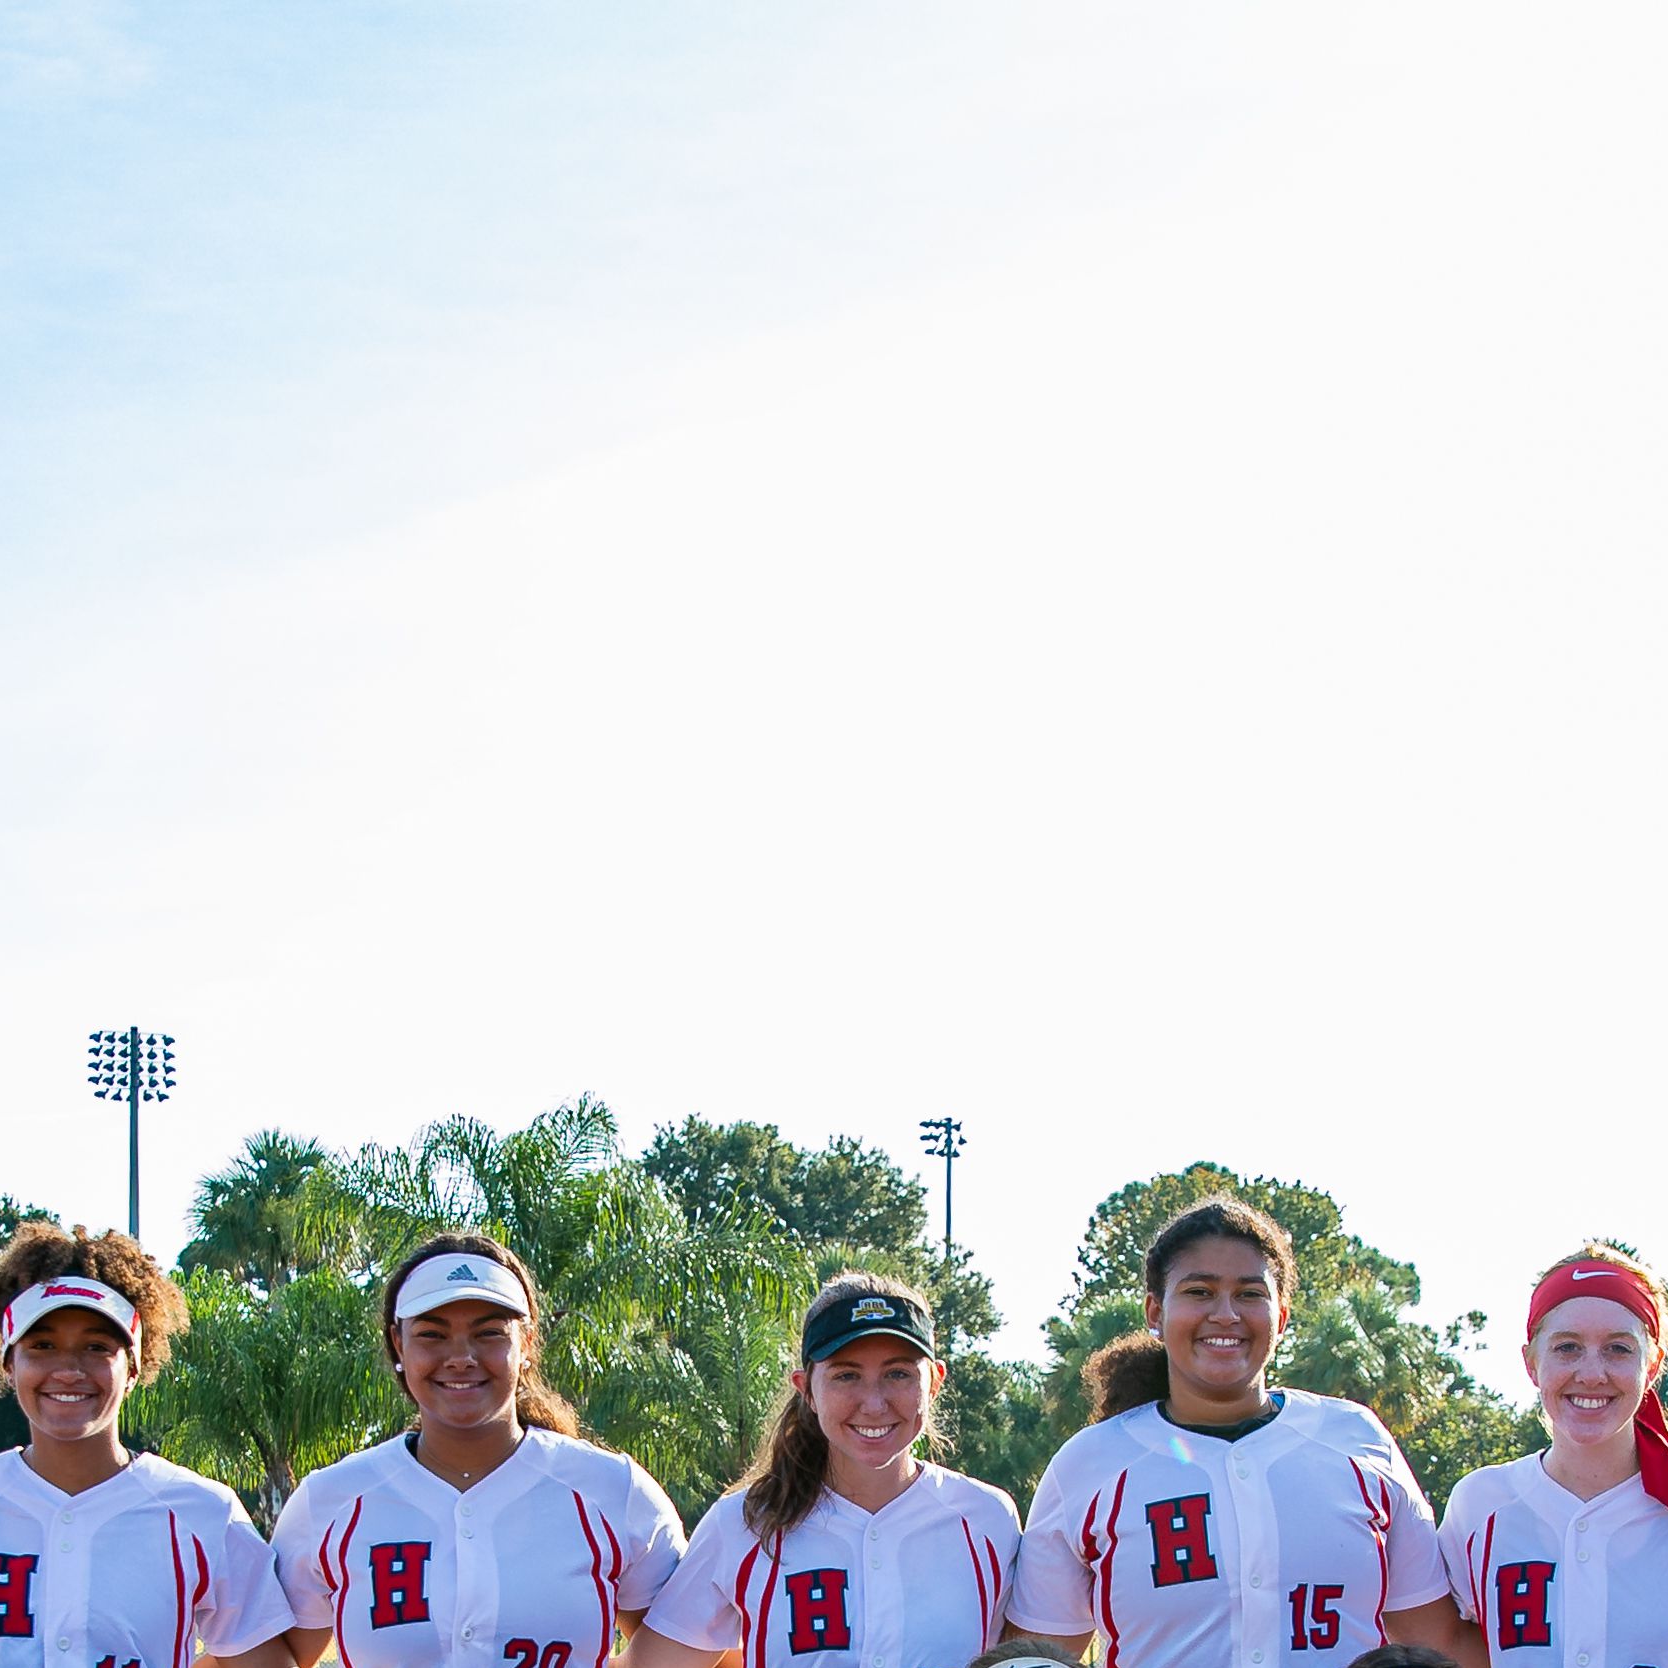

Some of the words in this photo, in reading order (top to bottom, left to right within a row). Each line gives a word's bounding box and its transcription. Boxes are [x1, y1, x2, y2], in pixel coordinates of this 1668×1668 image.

[1145, 1492, 1218, 1588] H
[368, 1541, 432, 1629] H
[785, 1568, 850, 1656] H
[1289, 1584, 1344, 1651] 15
[1495, 1560, 1556, 1650] H
